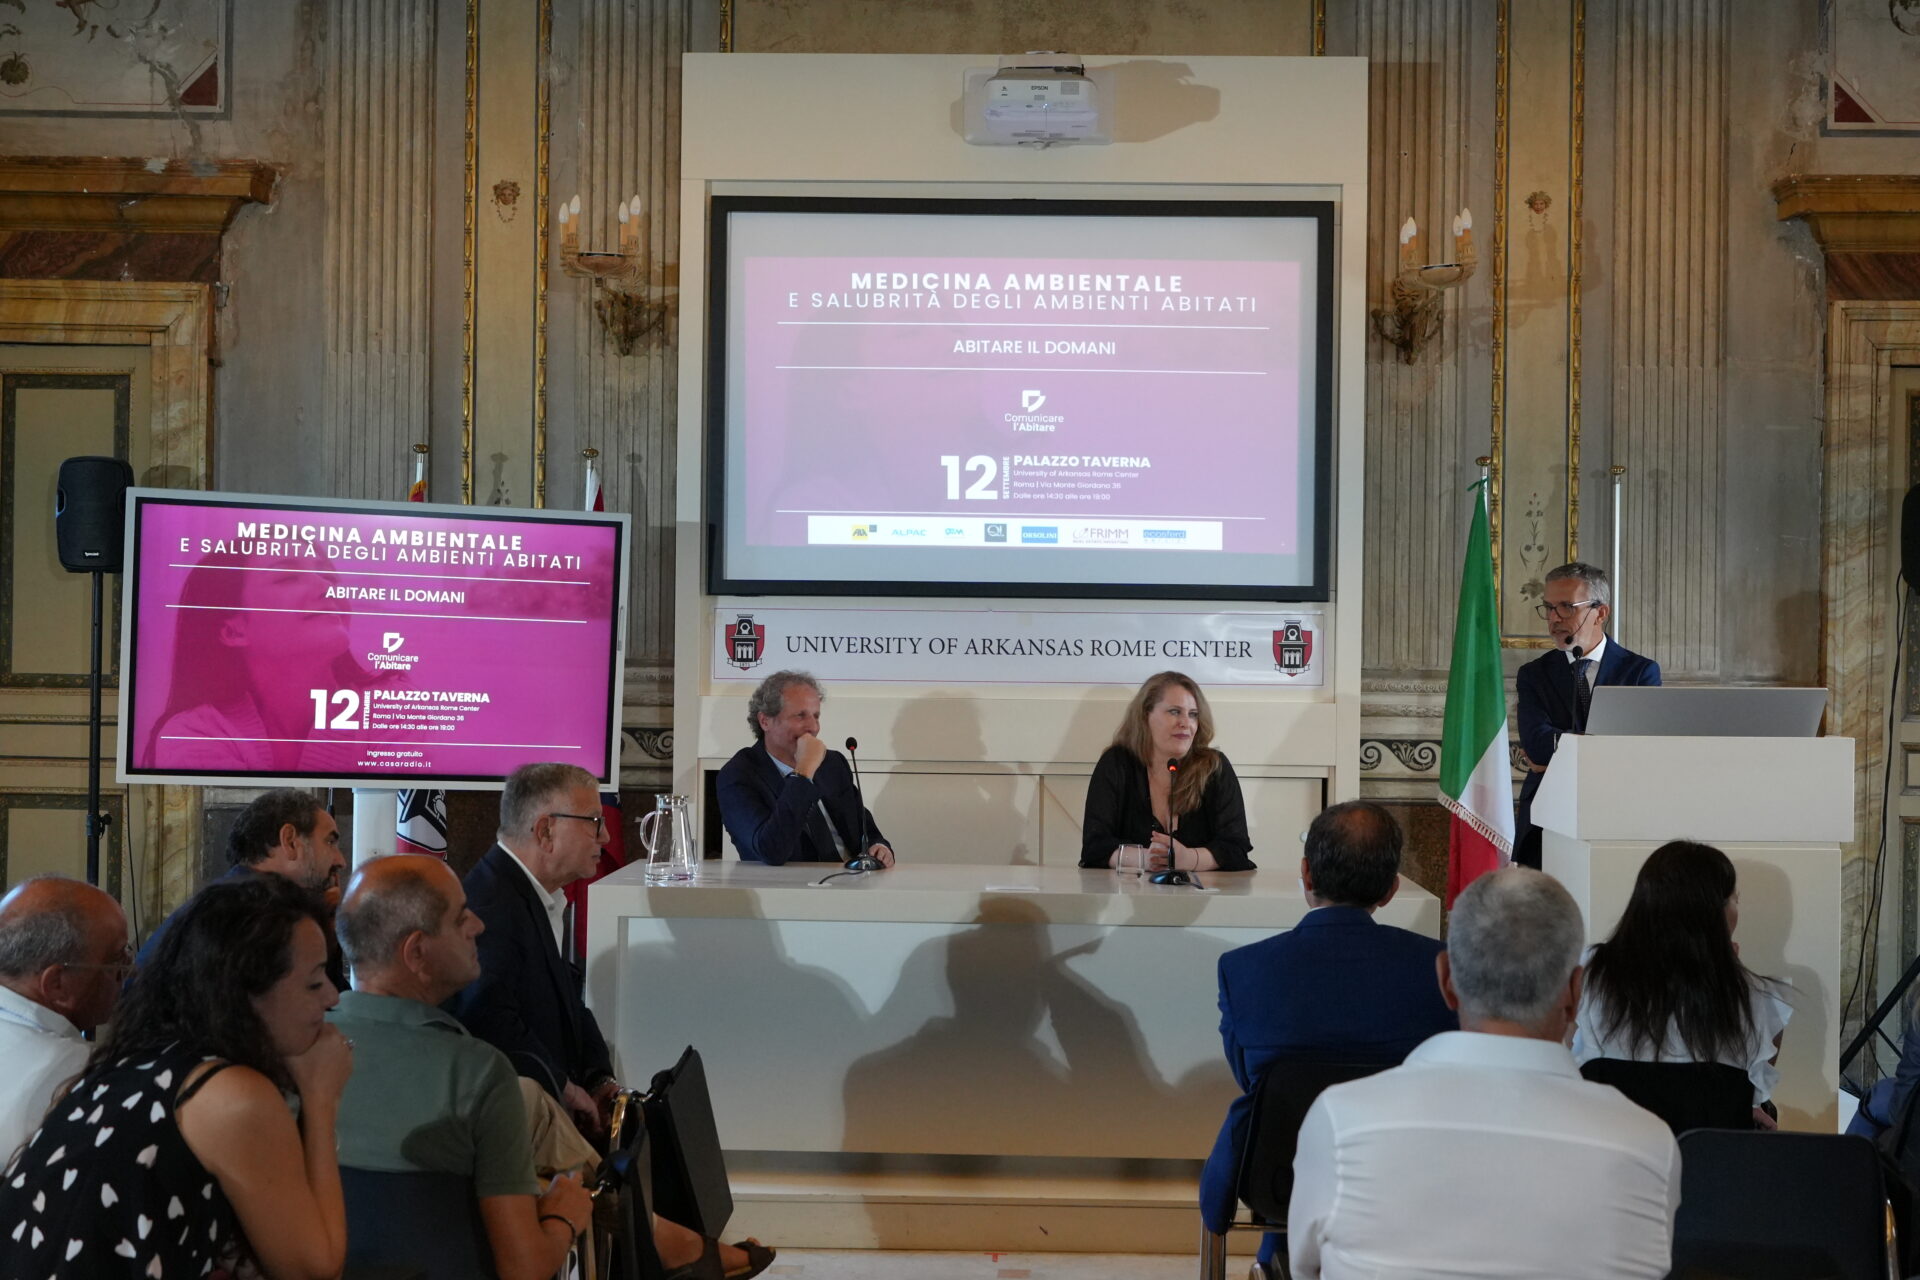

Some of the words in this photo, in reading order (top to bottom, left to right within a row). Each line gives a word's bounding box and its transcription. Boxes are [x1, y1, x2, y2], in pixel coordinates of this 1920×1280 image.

[851, 272, 991, 290] MEDICINA
[1004, 273, 1182, 292] AMBIENTALE
[788, 292, 799, 308] E
[811, 290, 941, 309] SALUBRITÀ
[953, 293, 1021, 309] DEGLI
[1033, 294, 1148, 310] AMBIENTI
[1161, 296, 1256, 312] ABITATI
[953, 339, 1023, 354] ABITARE
[1028, 340, 1040, 354] IL
[1045, 341, 1116, 355] DOMANI
[1004, 412, 1064, 423] Comunicare
[1013, 422, 1056, 432] l'Abitare
[1013, 455, 1079, 467] PALAZZO
[1082, 455, 1151, 468] TAVERNA
[940, 455, 998, 500] 12
[1002, 456, 1010, 499] SETTEMBRE
[1013, 469, 1047, 478] University
[237, 522, 361, 543] MEDICINA
[371, 528, 521, 550] AMBIENTALE
[1090, 527, 1129, 539] FRIMM
[180, 538, 189, 552] E
[201, 539, 316, 558] SALUBRITÀ
[327, 545, 386, 561] DEGLI
[397, 549, 493, 566] AMBIENTI
[504, 553, 581, 570] ABITATI
[325, 586, 386, 600] ABITARE
[390, 589, 401, 601] IL
[405, 590, 465, 603] DOMANI
[786, 636, 922, 654] UNIVERSITY
[928, 637, 958, 655] OF
[964, 638, 1084, 656] ARKANSAS
[1090, 639, 1156, 657] ROME
[1163, 640, 1253, 658] CENTER
[367, 652, 419, 662] Comunicare
[375, 661, 411, 670] l'Abitare
[373, 690, 430, 701] PALAZZO
[432, 691, 490, 703] TAVERNA
[310, 689, 360, 730] 12
[363, 691, 371, 729] SETTEMBRE
[373, 703, 403, 711] University
